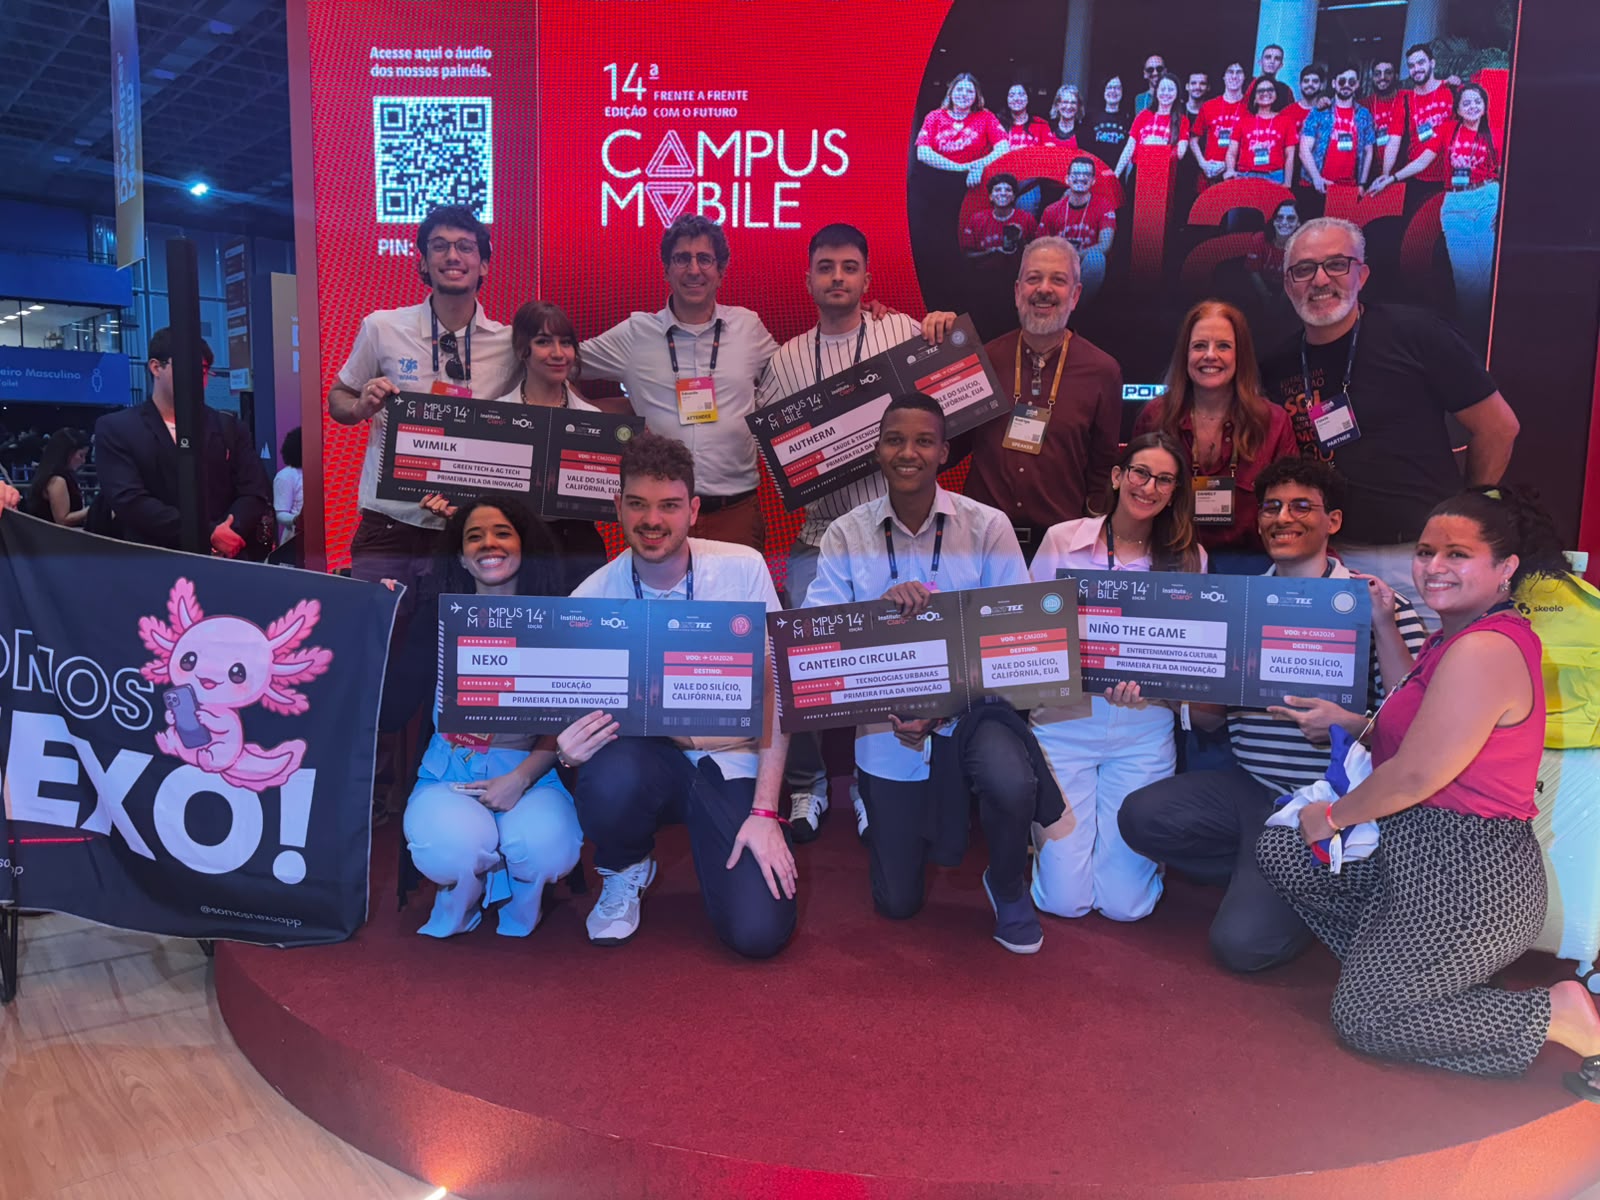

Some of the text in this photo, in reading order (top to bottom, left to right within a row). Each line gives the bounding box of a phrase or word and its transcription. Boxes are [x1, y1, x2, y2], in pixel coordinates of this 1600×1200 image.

[370, 46, 492, 62] Acesse aqui o áudio
[370, 63, 492, 80] dos nossos painéis.
[654, 90, 748, 101] FRENTE A FRENTE
[604, 104, 648, 119] EDIÇÃO
[653, 107, 738, 118] COM O FUTURO
[601, 129, 849, 178] CAMPUS
[378, 238, 414, 256] PIN:
[25, 368, 81, 380] Masculino
[788, 426, 836, 454] AUTHERM
[856, 426, 880, 441] TECNOLO
[1327, 433, 1351, 447] PARTNER
[413, 438, 457, 452] WIMILK
[1012, 442, 1033, 450] SPEAKER
[826, 453, 853, 468] PRIMEIRA
[852, 447, 864, 457] FILA
[452, 463, 473, 472] GREEN
[474, 465, 489, 474] TECH
[496, 467, 504, 475] AG
[505, 468, 521, 476] TECH
[437, 474, 523, 489] PRIMEIRA FILA DA INOVAÇÃO
[1079, 579, 1128, 590] CAMPUS
[1079, 589, 1119, 600] MOBILE
[467, 606, 522, 618] CAMPUS
[1533, 604, 1564, 612] skeelo
[467, 617, 513, 629] MOBILE
[793, 614, 844, 630] CAMPUS
[793, 625, 836, 639] MOBILE
[1089, 621, 1187, 639] NIÑO THE GAME
[471, 654, 508, 666] NEXO
[1127, 647, 1182, 657] ENTRETENIMENTO
[1189, 651, 1217, 660] CULTURA
[798, 650, 917, 672] CANTEIRO CIRCULAR
[991, 657, 1058, 670] VALE DO SILÍCIO,
[1116, 660, 1217, 674] PRIMEIRA FILA DA INOVAÇÃO
[1271, 656, 1343, 669] VALE DO SILÍCIO,
[856, 670, 939, 685] TECNOLOGIAS URBANAS
[991, 666, 1060, 681] CALIFÓRNIA, EUA
[1270, 665, 1343, 678] CALIFÓRNIA, EUA
[551, 681, 592, 690] EDUCAÇÃO
[709, 681, 741, 692] SILÍCIO,
[843, 683, 943, 700] PRIMEIRA FILA DA INOVAÇÃO
[512, 696, 549, 704] PRIMEIRA
[580, 696, 619, 706] INOVAÇÃO
[672, 692, 724, 702] CALIFÓRNIA,
[455, 734, 475, 745] ALPHA
[0, 710, 317, 885] EXO!
[200, 905, 302, 928] @somosnexoapp
